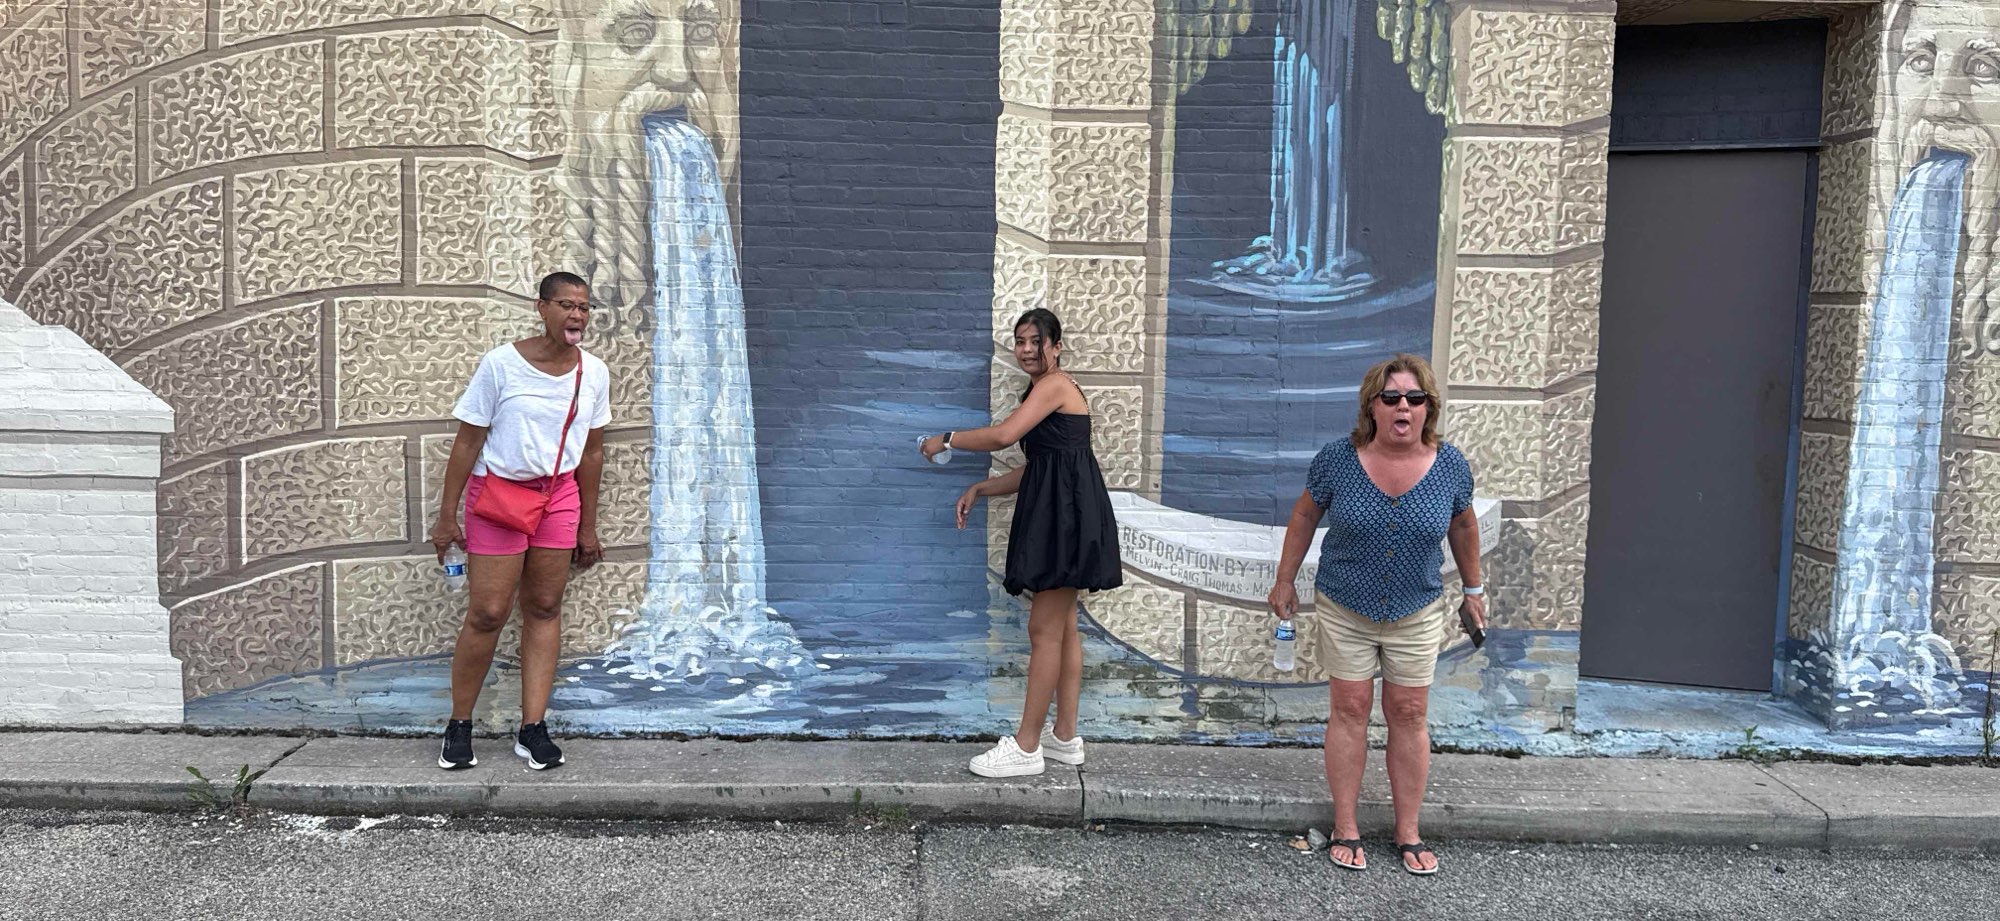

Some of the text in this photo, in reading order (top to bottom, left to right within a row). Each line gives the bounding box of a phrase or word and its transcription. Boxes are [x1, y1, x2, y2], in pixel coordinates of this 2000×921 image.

[1123, 526, 1219, 573] RESTORATION
[1225, 558, 1249, 577] BY
[1256, 562, 1315, 582] THAS
[1126, 545, 1162, 571] MELVIN
[1170, 563, 1199, 583] CRAIG
[1202, 571, 1242, 594] THOMAS
